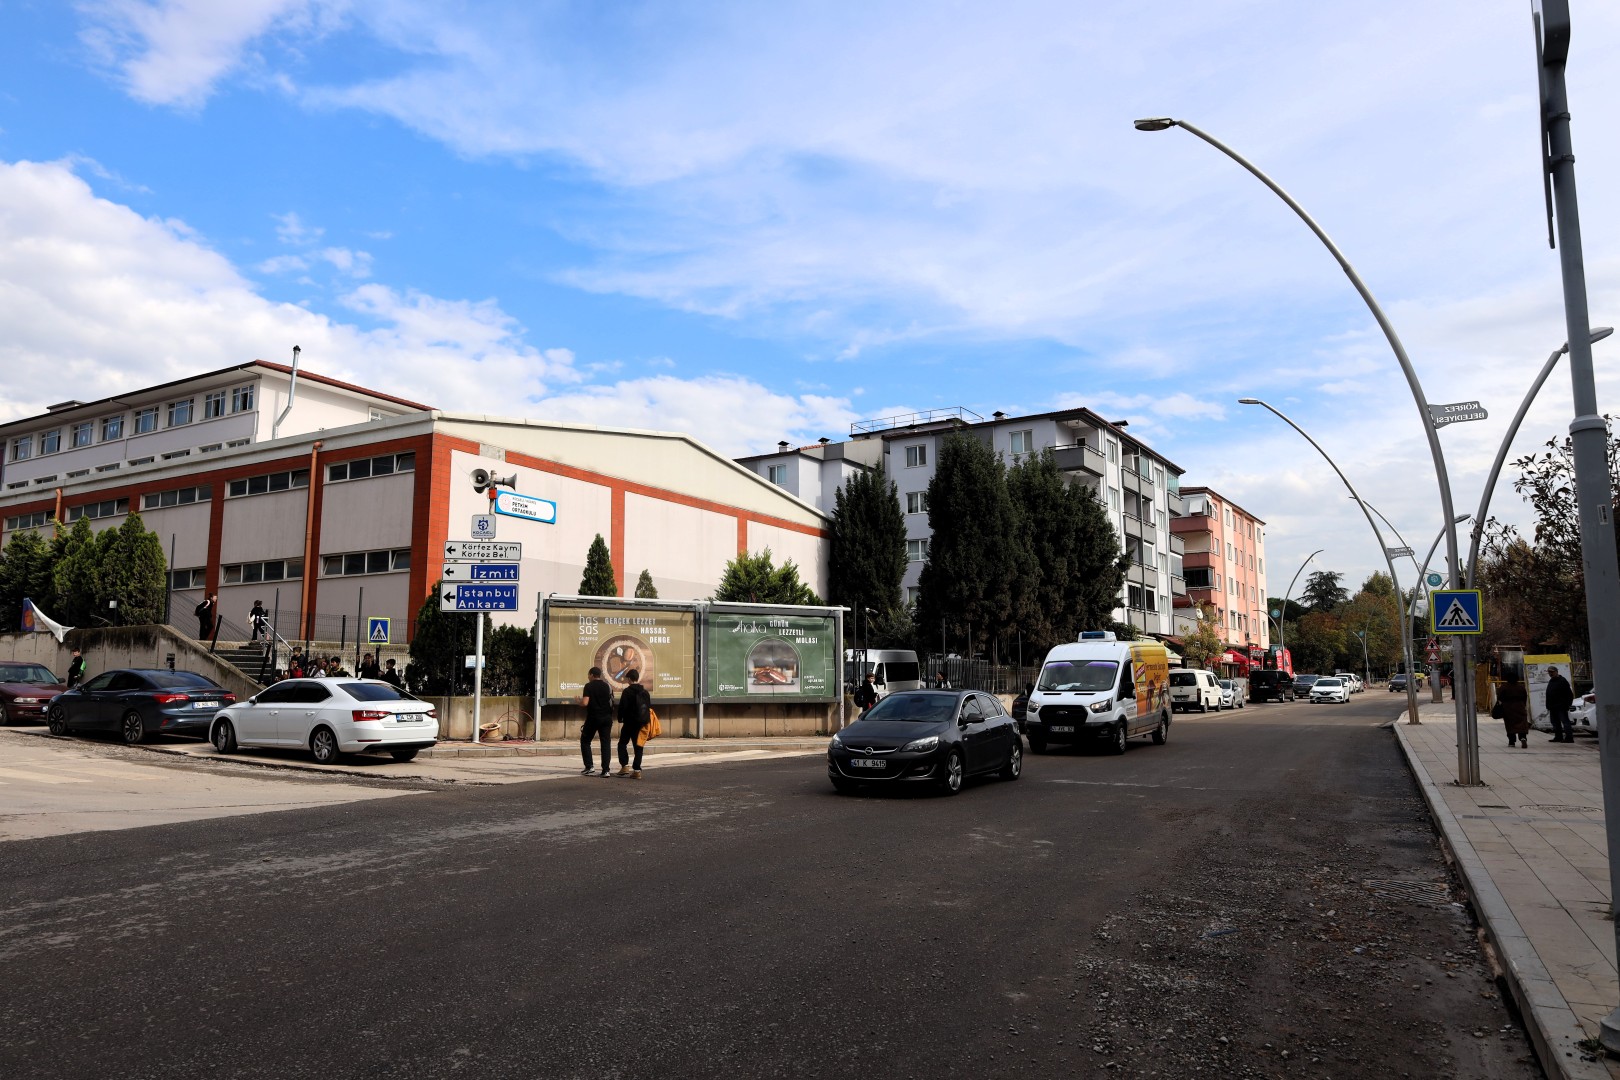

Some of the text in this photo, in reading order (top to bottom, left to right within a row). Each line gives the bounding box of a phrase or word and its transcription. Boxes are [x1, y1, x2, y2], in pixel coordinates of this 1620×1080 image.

[493, 544, 520, 553] Kaym.
[474, 566, 515, 578] İzmit
[460, 586, 516, 598] İstanbul
[458, 600, 506, 608] Ankara
[579, 614, 598, 625] has
[604, 618, 630, 626] GERÇEK
[579, 626, 598, 634] sas
[778, 628, 804, 636] LEZZETLİ
